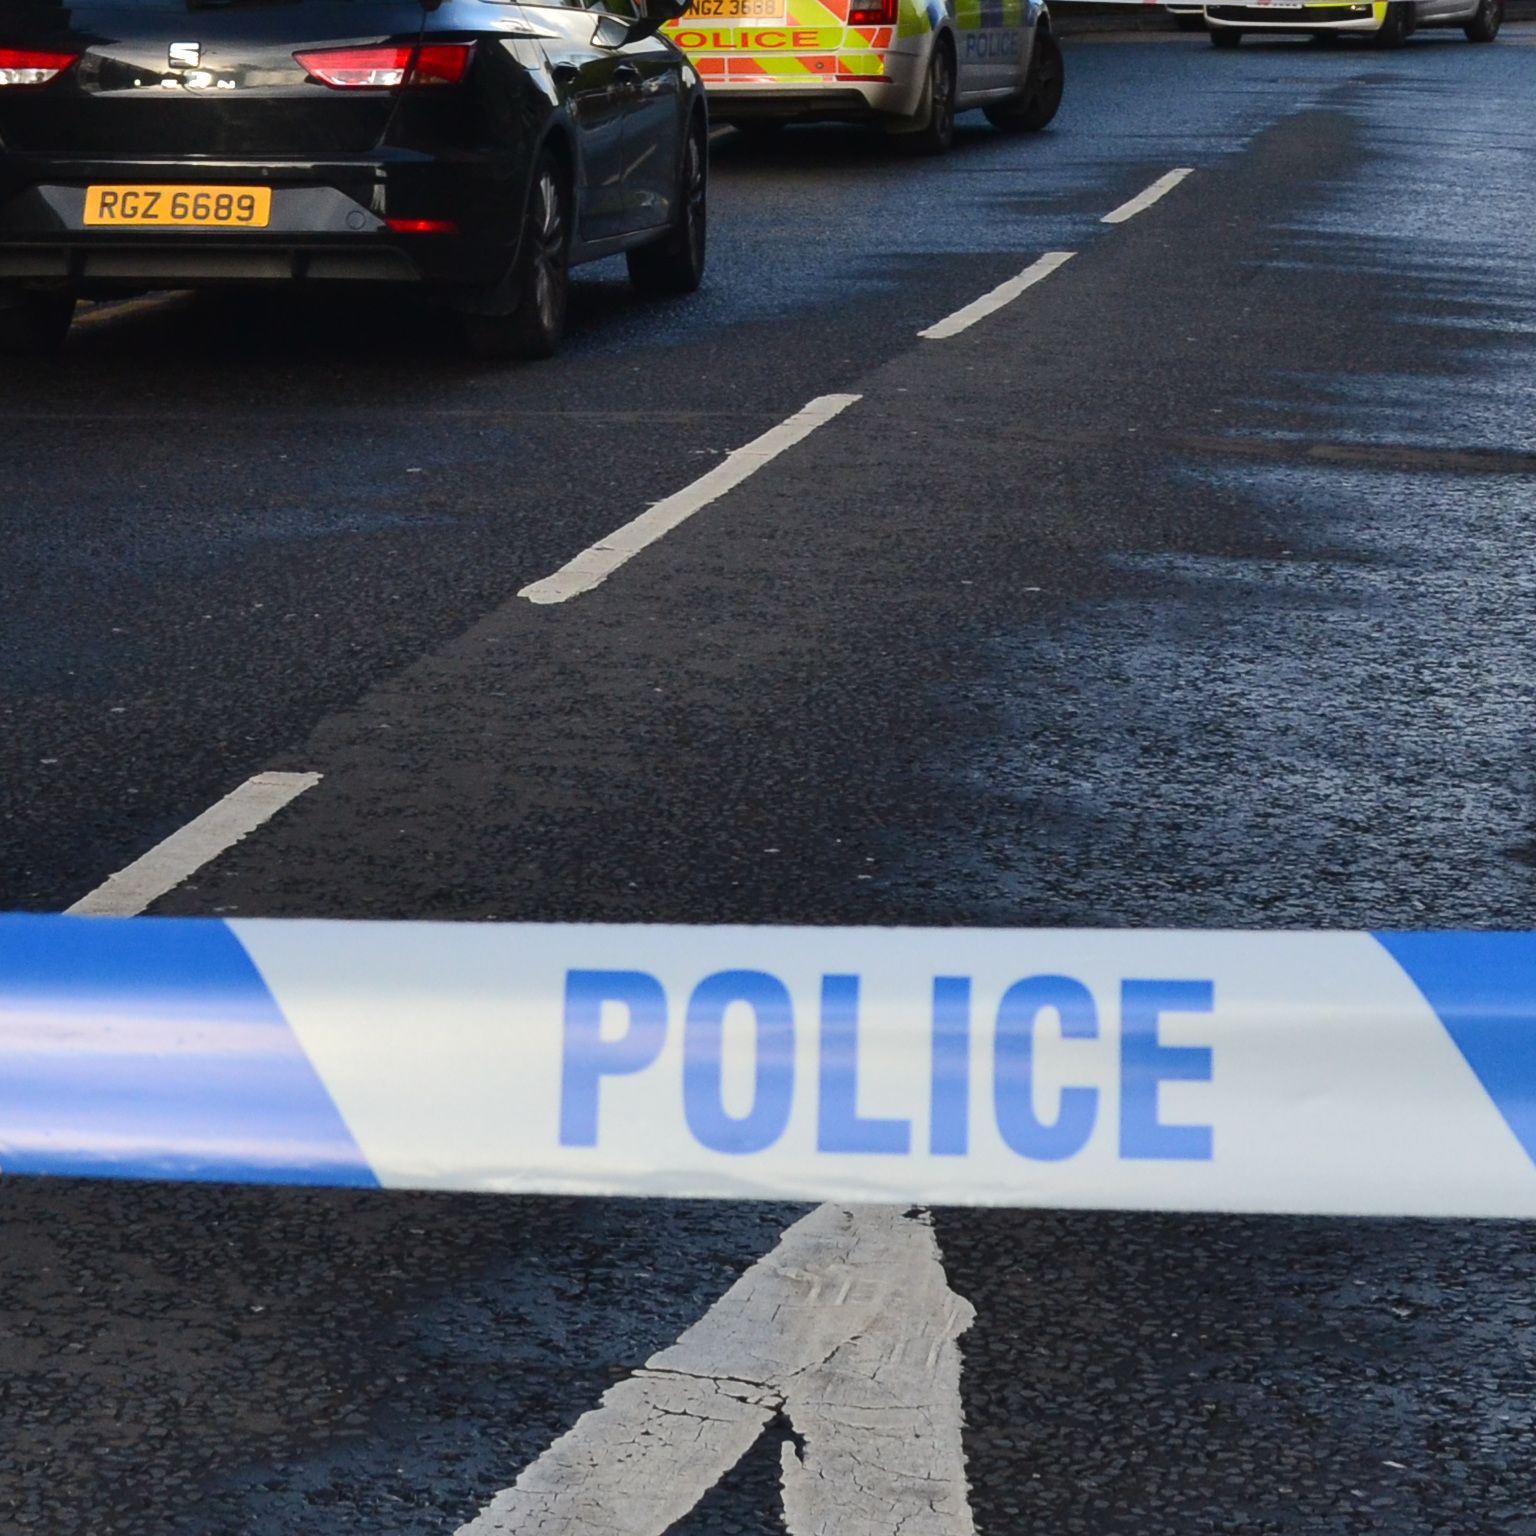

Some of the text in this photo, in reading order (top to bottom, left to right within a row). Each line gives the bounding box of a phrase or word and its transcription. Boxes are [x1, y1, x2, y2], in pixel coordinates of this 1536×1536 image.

[689, 0, 723, 15] NGZ
[673, 31, 820, 48] OLICE
[966, 32, 1018, 57] POLICE
[98, 191, 256, 222] RGZ 6689
[558, 967, 1215, 1163] POLICE
